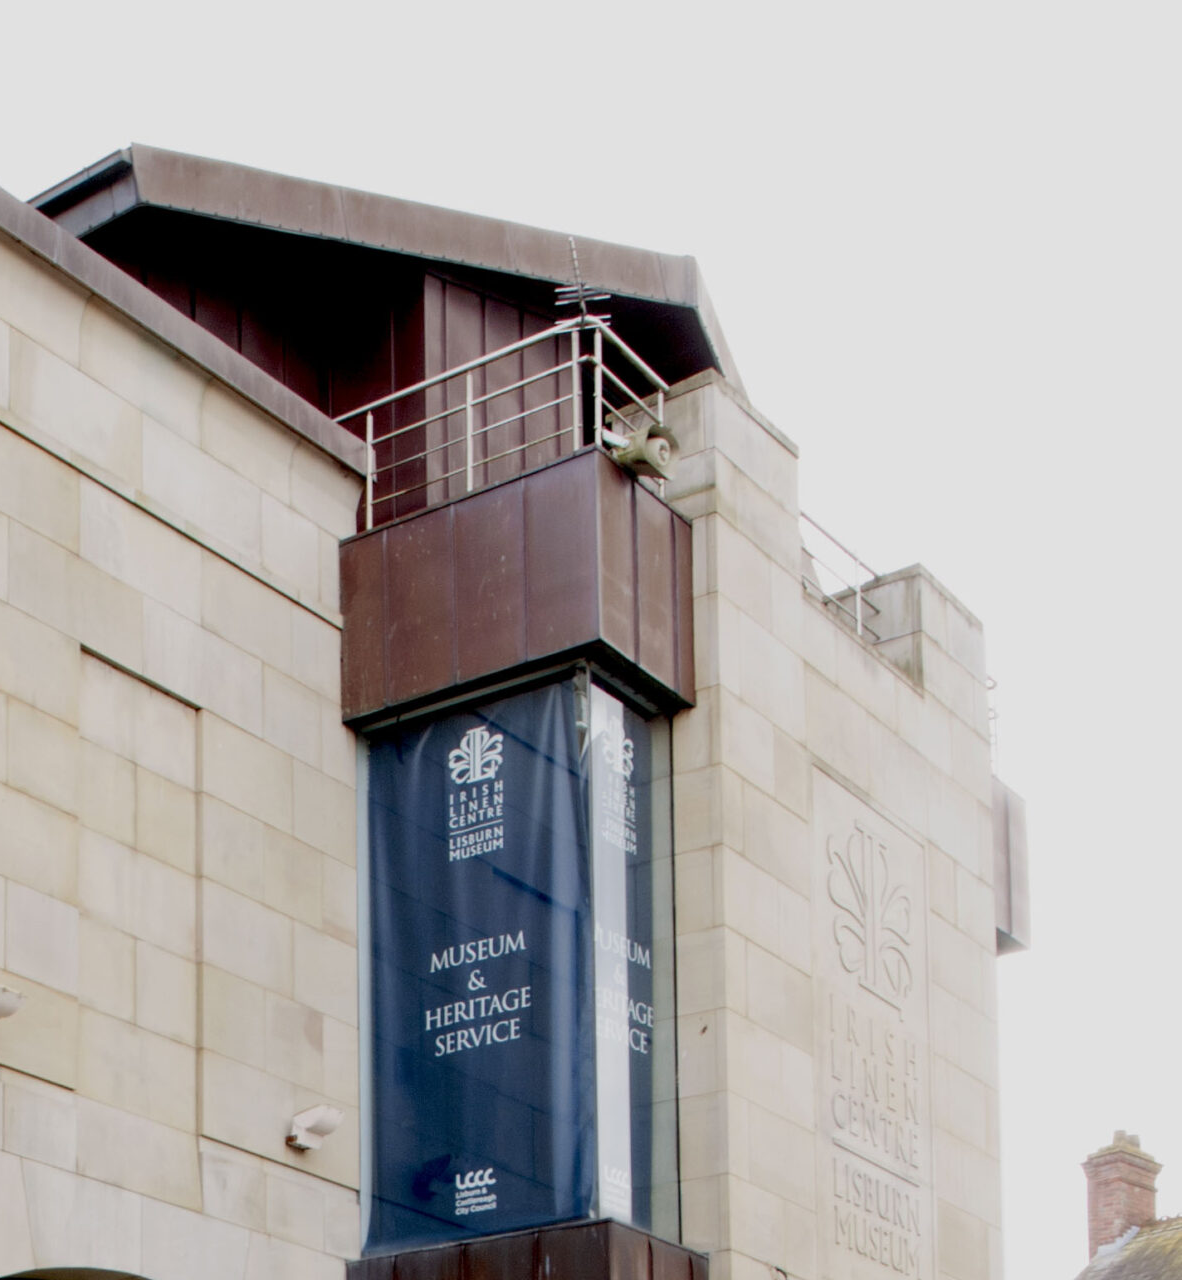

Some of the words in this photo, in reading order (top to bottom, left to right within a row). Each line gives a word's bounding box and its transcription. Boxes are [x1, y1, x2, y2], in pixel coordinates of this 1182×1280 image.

[449, 780, 504, 806] IRISH
[449, 793, 504, 818] LINEN
[449, 805, 504, 829] CENTRE
[449, 825, 504, 850] LISBURN
[449, 838, 504, 862] MUSEUM
[430, 930, 526, 973] MUSEUM
[468, 968, 487, 991] &
[425, 986, 531, 1041] HERITAGE
[435, 1018, 520, 1057] SERVICE
[828, 993, 919, 1082] IRISH
[830, 1039, 920, 1127] LINEN
[831, 1090, 920, 1170] CENTRE
[455, 1168, 497, 1189] LCCC
[470, 1201, 497, 1212] Council
[832, 1157, 922, 1237] LISBURN
